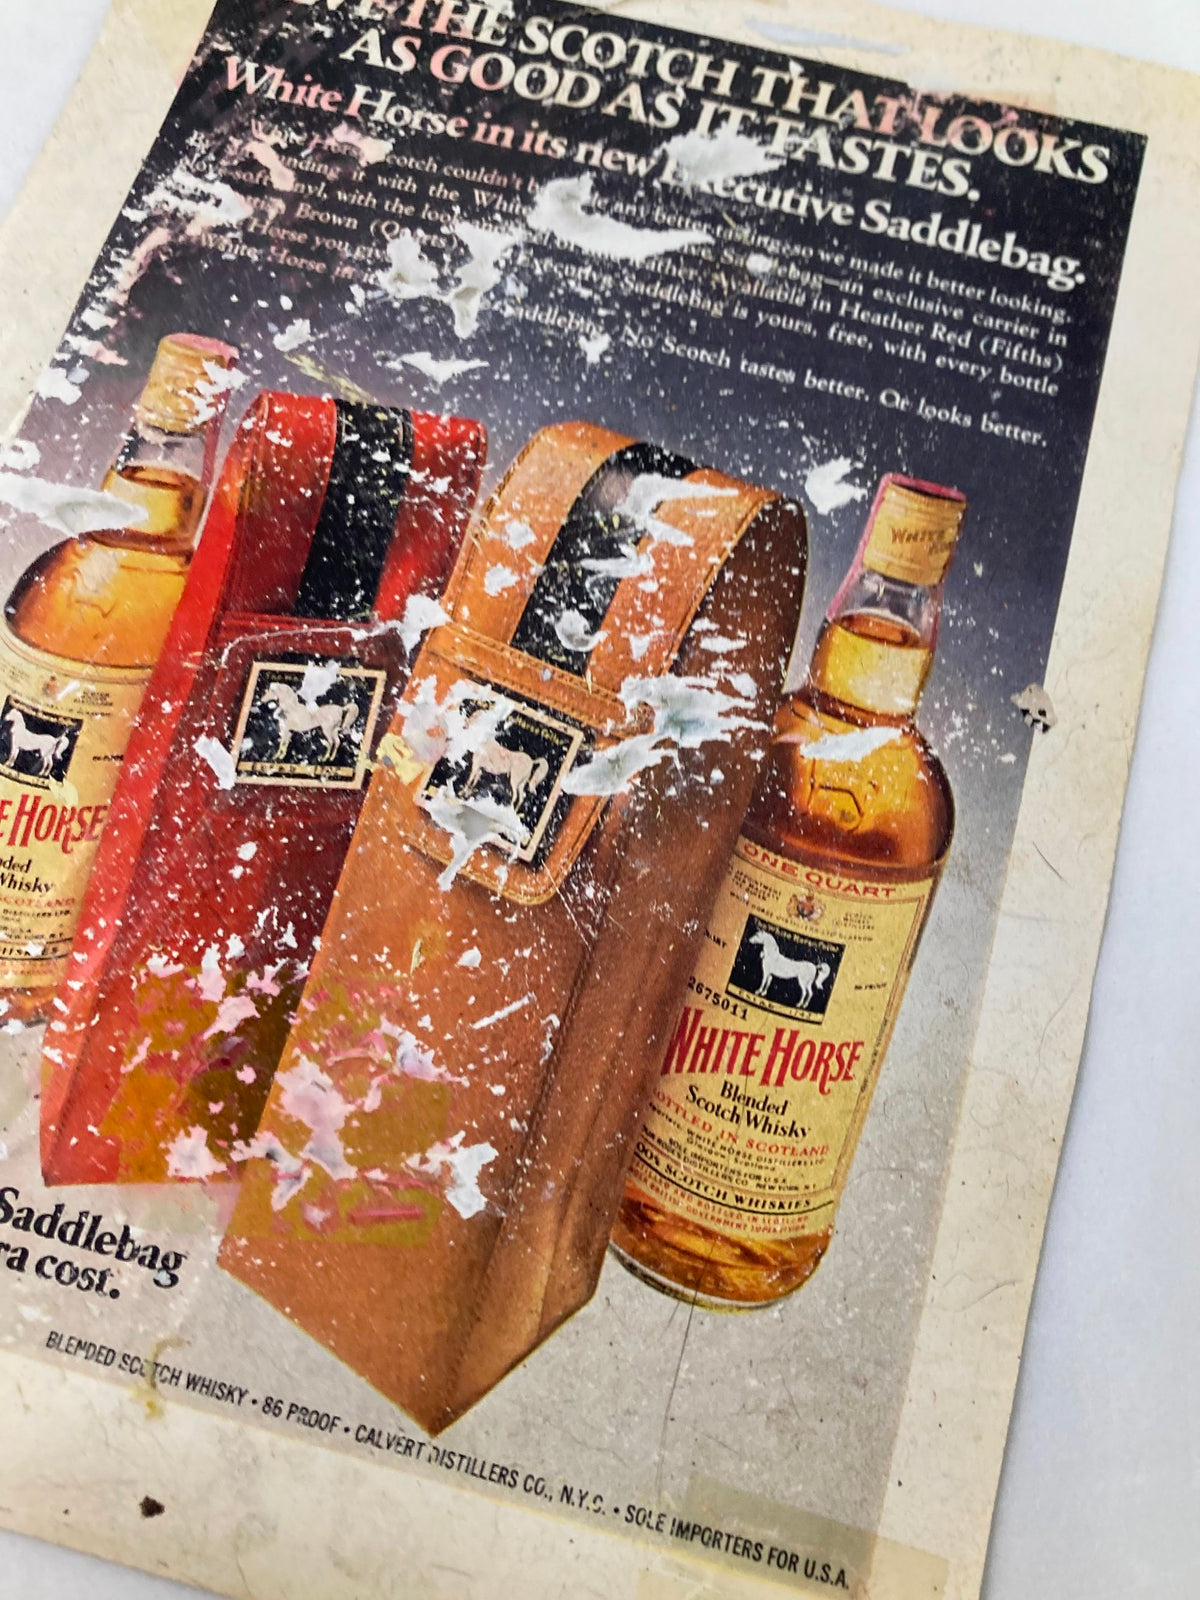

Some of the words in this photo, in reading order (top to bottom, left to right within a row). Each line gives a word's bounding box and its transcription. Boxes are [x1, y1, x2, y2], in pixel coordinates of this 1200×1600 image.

[339, 27, 422, 73] AS
[430, 44, 601, 109] GOOD
[601, 81, 684, 129] AS
[763, 115, 981, 202] TASTES.
[518, 15, 739, 96] SCOTCH
[751, 65, 902, 136] THAT
[919, 105, 1111, 185] LOOKS
[225, 55, 342, 113] White
[344, 83, 469, 138] Horse
[471, 110, 516, 149] in
[519, 119, 568, 159] its
[573, 141, 658, 178] new
[659, 156, 855, 226] Eecutive
[859, 199, 1086, 293] Saddlebag.
[335, 190, 377, 209] with
[383, 198, 416, 218] the
[812, 294, 831, 314] in
[838, 299, 925, 337] Heather
[930, 322, 972, 349] Red
[979, 335, 1063, 374] (Fifths)
[376, 174, 417, 194] with
[428, 182, 460, 201] the
[872, 287, 964, 320] exclusive
[972, 313, 1040, 339] carrier
[1048, 326, 1068, 347] in
[385, 152, 438, 174] cotch
[443, 164, 523, 191] couldn't
[819, 249, 845, 266] we
[849, 256, 903, 280] made
[908, 266, 923, 285] it
[926, 270, 986, 301] better
[989, 287, 1071, 326] looking.
[295, 201, 359, 231] Brown
[733, 300, 748, 319] is
[755, 310, 817, 338] yours,
[828, 321, 873, 351] free,
[884, 339, 927, 363] with
[935, 354, 992, 382] every
[1000, 364, 1060, 397] bottle
[623, 323, 653, 349] No
[661, 335, 731, 369] Scotch
[740, 356, 796, 384] tastes
[804, 368, 869, 402] better.
[879, 388, 911, 412] Or
[917, 396, 972, 428] looks
[981, 412, 1047, 448] better.
[8, 795, 108, 854] HORSE
[743, 842, 798, 877] ONE
[805, 871, 897, 899] QUART
[688, 976, 748, 1021] 2675011
[660, 1006, 765, 1077] WHITE
[759, 1027, 864, 1095] HORSE
[654, 1089, 712, 1133] OTTLED
[720, 1129, 738, 1145] IN
[745, 1138, 830, 1157] SCOTLAND
[686, 1084, 741, 1125] Scotch
[746, 1110, 811, 1141] Whisky
[720, 1080, 789, 1117] Blended
[665, 1164, 728, 1200] SCOTCH
[734, 1191, 811, 1210] WHISKIES
[720, 1144, 753, 1161] HORSE
[35, 1254, 120, 1299] cost.
[46, 1330, 117, 1367] BLENDED
[185, 1372, 250, 1405] WHISKY
[262, 1396, 284, 1419] 86
[287, 1403, 341, 1434] PROOF
[354, 1424, 426, 1460] CALVERT
[428, 1446, 520, 1489] DISTILLERS
[624, 1503, 668, 1533] SOLE
[669, 1517, 764, 1562] IMPORTERS
[766, 1546, 800, 1573] FOR
[803, 1558, 850, 1590] U.S.A.
